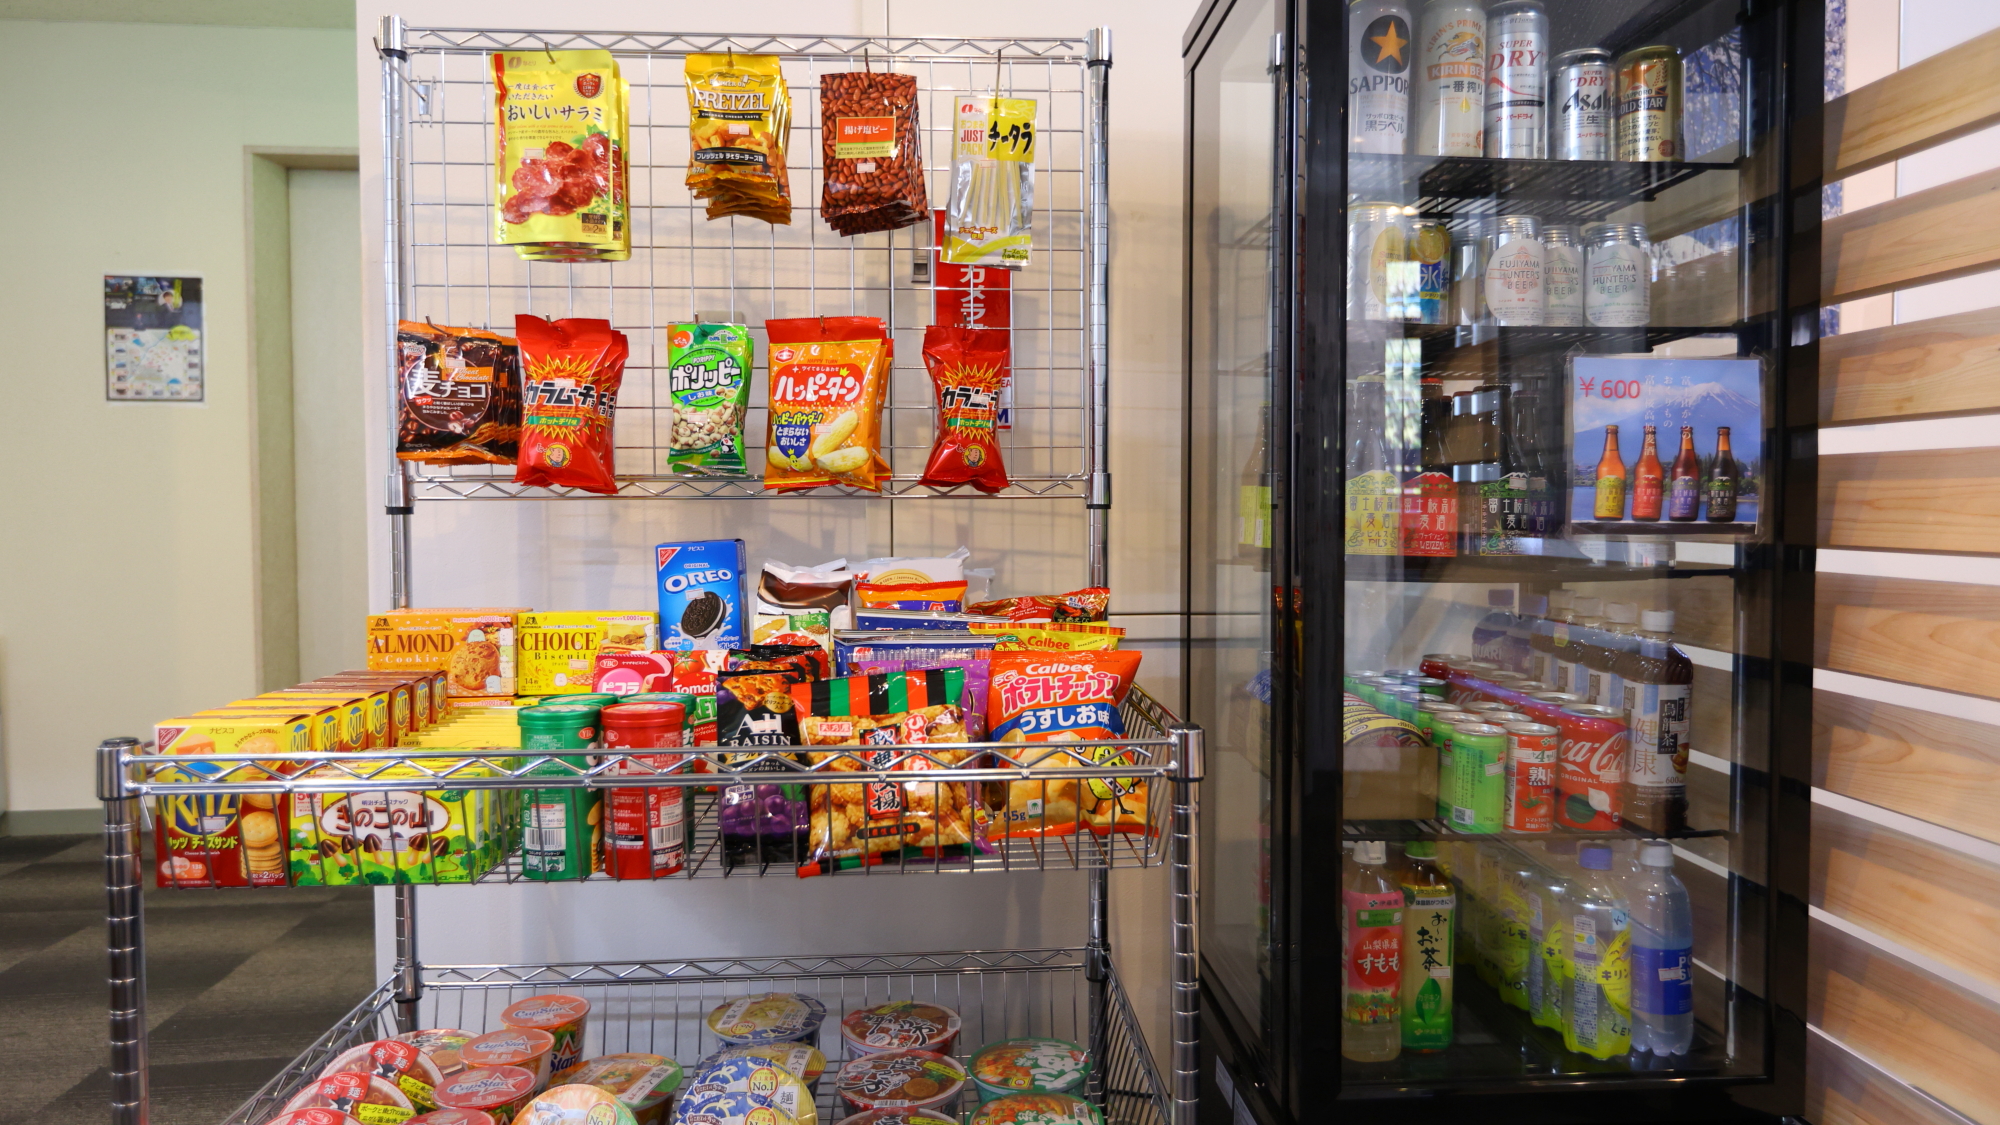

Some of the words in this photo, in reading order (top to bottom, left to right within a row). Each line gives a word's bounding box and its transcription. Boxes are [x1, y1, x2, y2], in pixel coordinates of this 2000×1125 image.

[1426, 22, 1455, 53] KIRIN'S
[1457, 19, 1482, 31] PRIME
[1498, 40, 1533, 50] SUPER
[1432, 64, 1468, 77] KIRIN
[507, 83, 556, 91] 一度は食べて
[693, 90, 770, 111] PRETZEL
[1638, 97, 1663, 111] STAR
[507, 104, 603, 123] おいしいサラミ
[1586, 115, 1600, 124] 生
[960, 120, 985, 129] おつまみ
[1365, 120, 1405, 134] 黒ラベル
[961, 129, 985, 143] JUST
[988, 120, 1033, 154] チータラ
[696, 152, 724, 160] プレッツェル
[960, 144, 984, 155] PACK
[1500, 260, 1540, 269] FUJIYAMA
[1508, 281, 1534, 290] BEER
[1592, 275, 1637, 285] HUNTER'S
[1546, 288, 1573, 296] BEER
[1600, 285, 1629, 295] BEER
[671, 358, 742, 393] ポリッピー
[410, 367, 487, 398] 麦チョコ
[773, 373, 861, 402] ハッピーターン
[525, 379, 597, 408] カラムーチョ
[687, 390, 714, 400] しお味
[1663, 375, 1674, 428] おくりもの
[539, 417, 578, 426] ホットチリ味
[776, 427, 810, 436] とまらない
[780, 437, 807, 446] おいしさ
[1366, 513, 1391, 529] 麦酒
[1420, 515, 1446, 531] 麦酒
[1368, 538, 1388, 548] PILS
[665, 569, 733, 593] OREO
[370, 633, 455, 653] ALMOND
[520, 632, 597, 651] CHOICE
[1027, 635, 1071, 650] Calbee
[385, 655, 439, 663] Cookie
[534, 652, 587, 660] Biscuit
[603, 659, 616, 667] YBC
[1025, 662, 1094, 675] Calbee
[602, 681, 640, 695] ピコラ
[1002, 671, 1122, 718] ポテトチップス
[1019, 704, 1111, 733] うすしお味
[730, 735, 792, 747] RAISIN
[905, 714, 932, 771] ひとち
[1631, 718, 1658, 777] 健康
[1560, 772, 1598, 784] ORIGINAL
[336, 802, 435, 832] きのこの山
[1363, 938, 1399, 950] 山梨県産
[1417, 926, 1443, 972] お茶
[1357, 952, 1399, 975] すもも
[513, 1006, 564, 1018] CupStar
[474, 1040, 526, 1051] CupStar
[448, 1079, 509, 1094] CupStar
[752, 1081, 775, 1092] No.1
